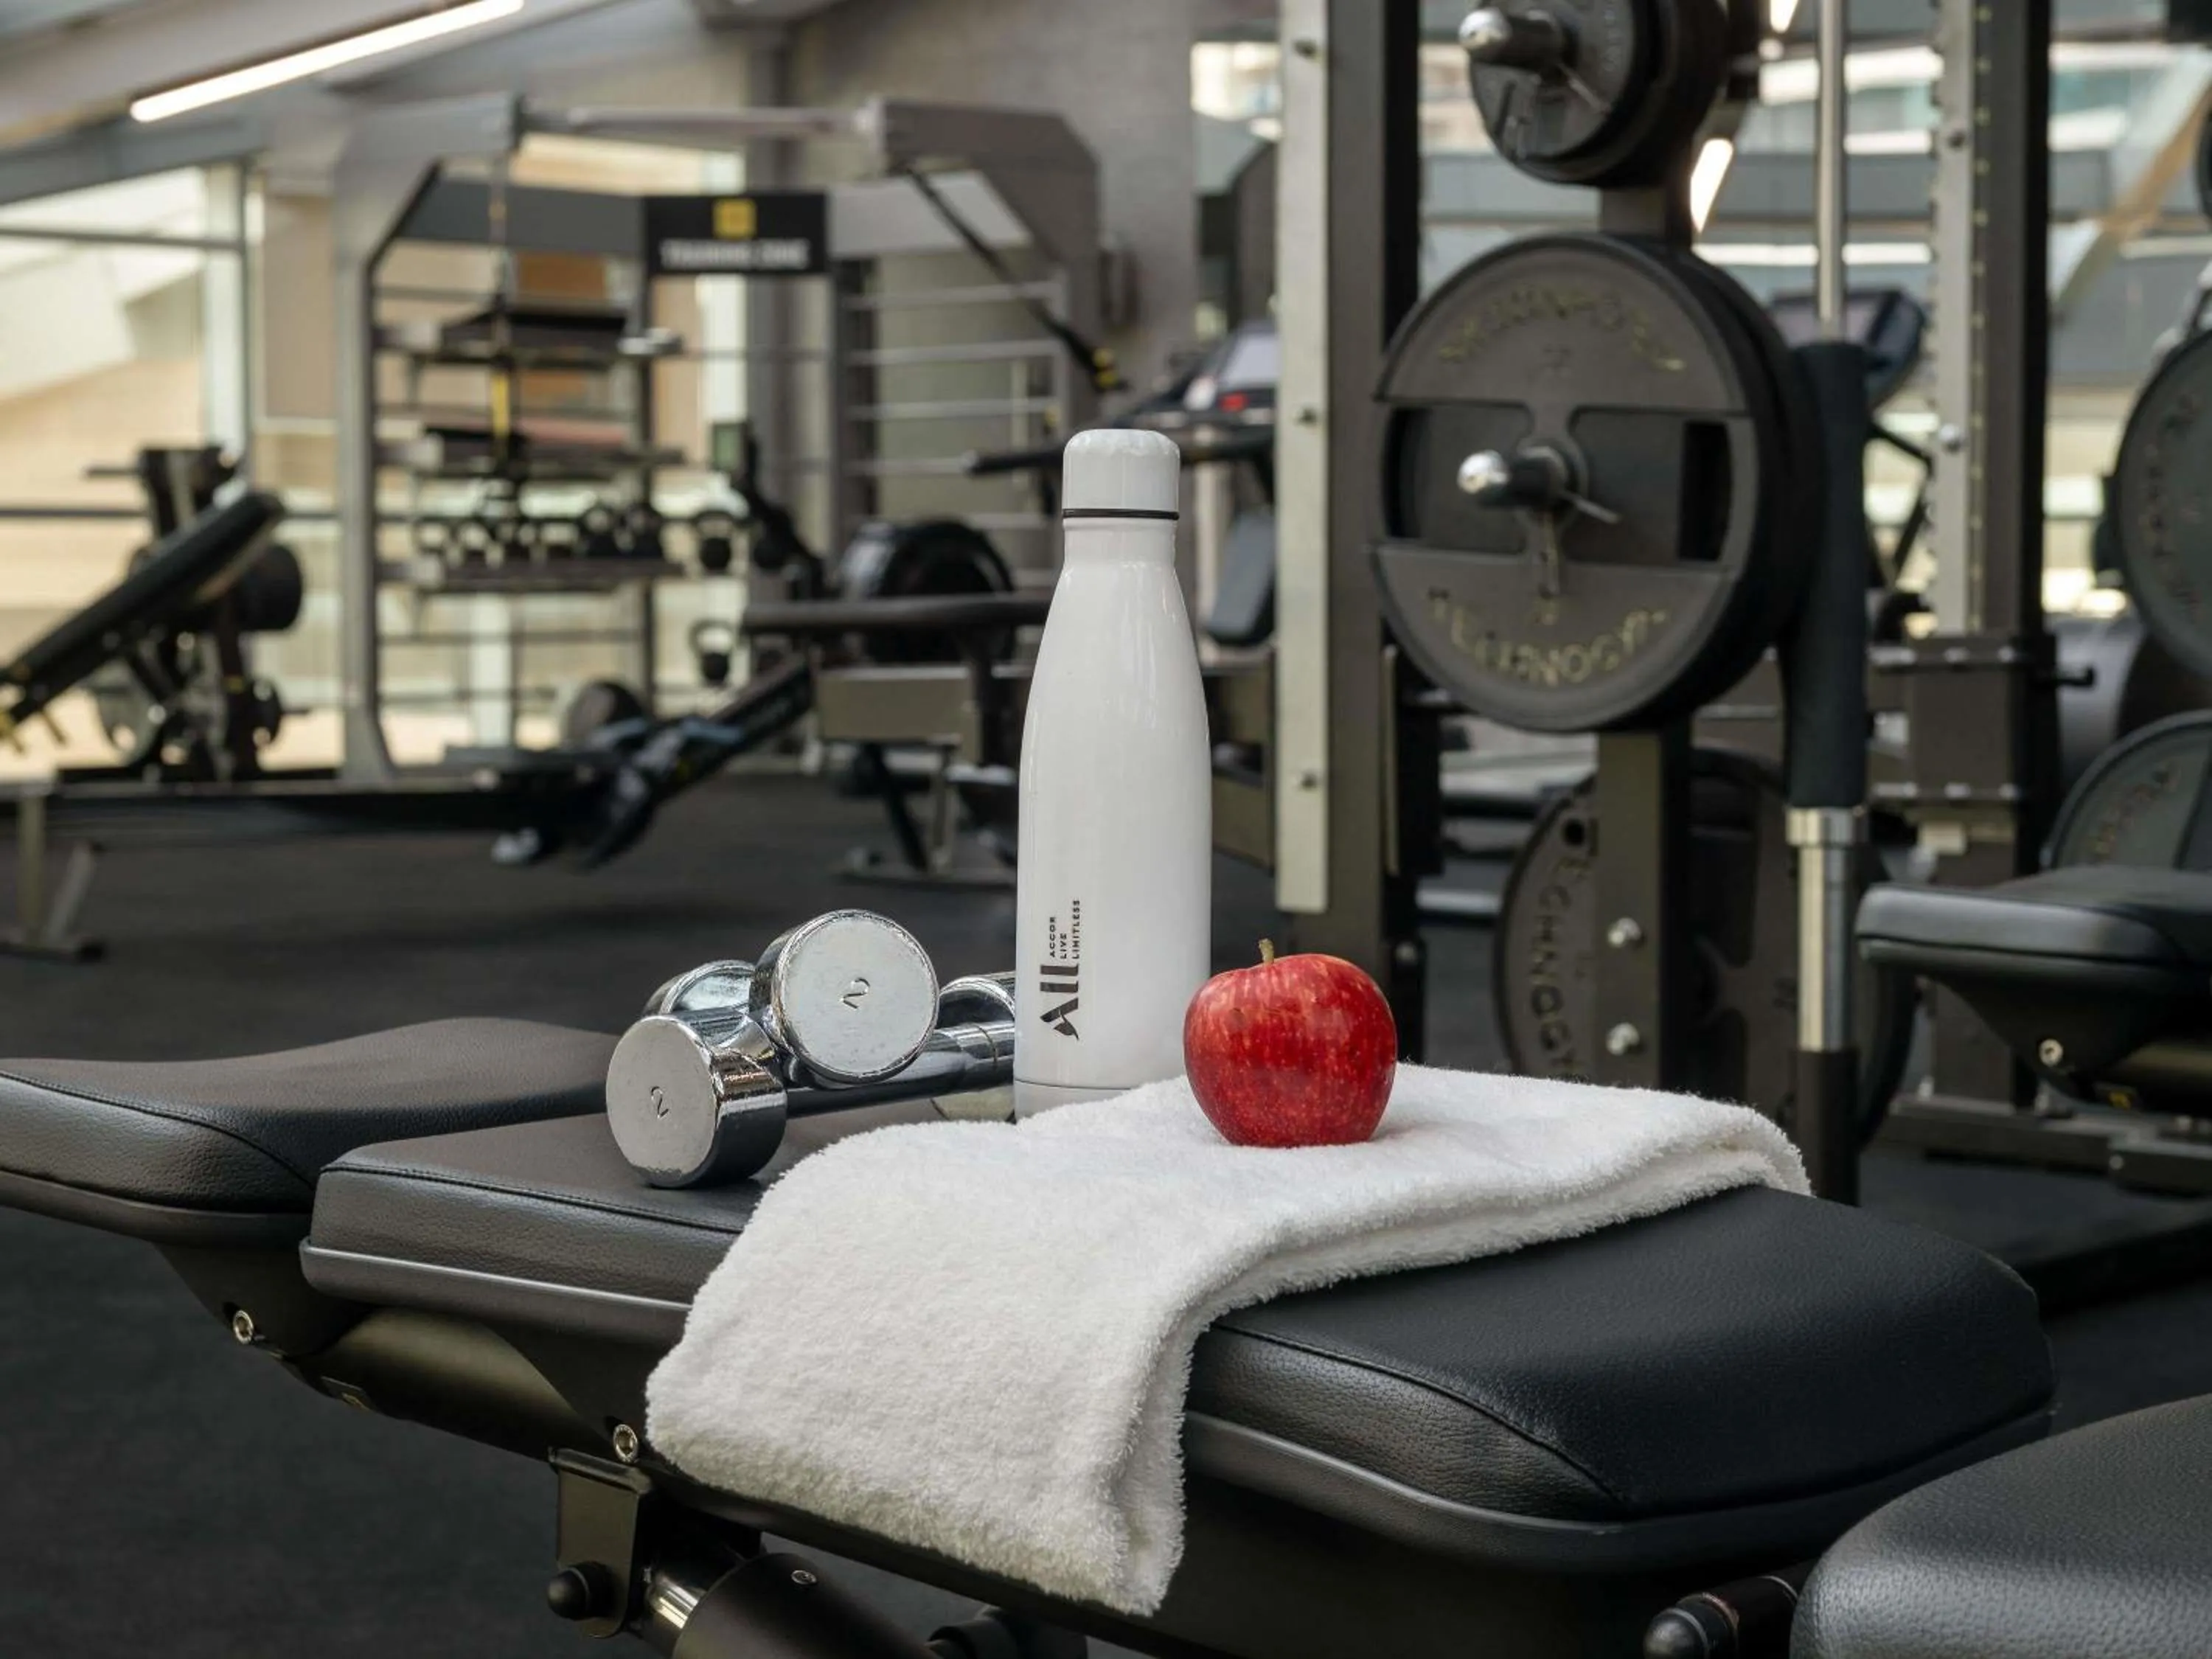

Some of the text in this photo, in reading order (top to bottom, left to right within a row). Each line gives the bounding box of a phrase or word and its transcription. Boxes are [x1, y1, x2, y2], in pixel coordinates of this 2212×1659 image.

[1071, 900, 1080, 959] LIMITLESS
[839, 977, 871, 1009] 2
[650, 1085, 669, 1119] 2
